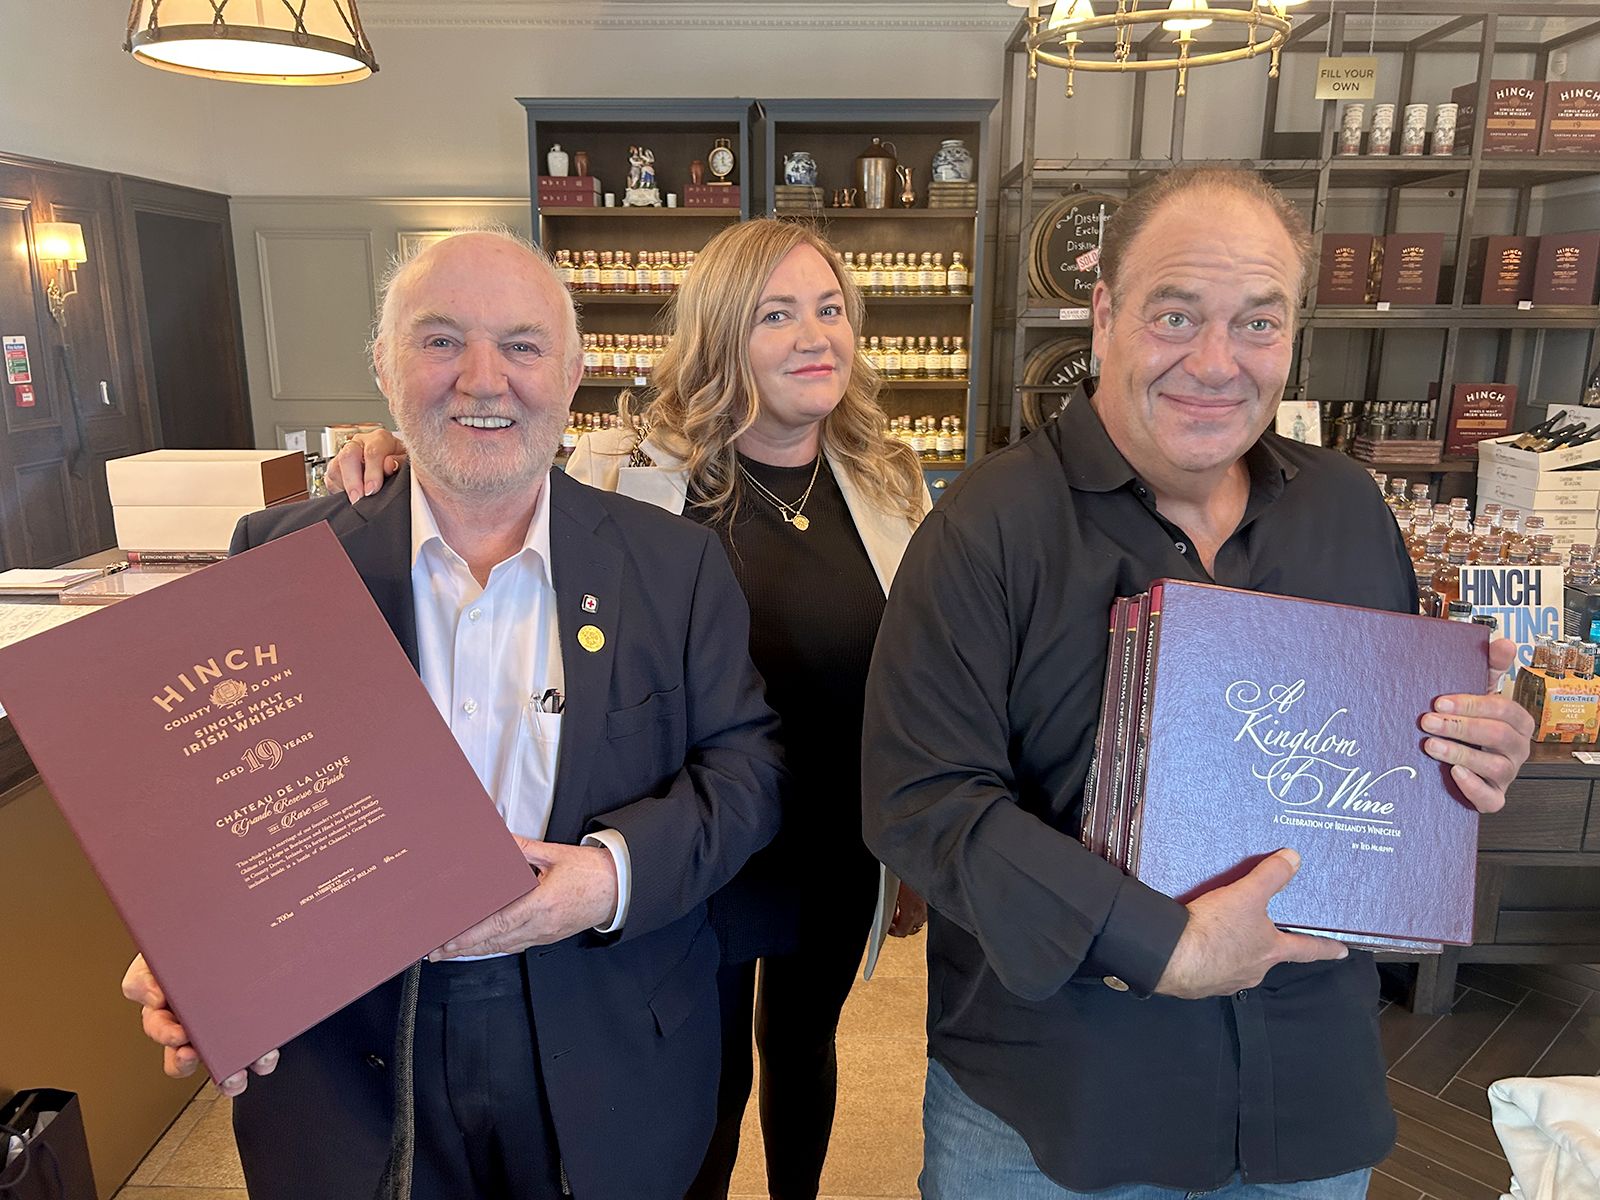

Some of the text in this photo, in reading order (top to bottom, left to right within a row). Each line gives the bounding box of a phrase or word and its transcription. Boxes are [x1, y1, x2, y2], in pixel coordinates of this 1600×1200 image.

[1321, 70, 1374, 78] FILL YOUR
[1333, 83, 1359, 91] OWN
[1496, 87, 1534, 100] HINCH
[1560, 89, 1600, 101] HINCH
[1080, 252, 1098, 268] SOLD
[1074, 279, 1091, 290] Pric
[1052, 357, 1087, 386] HIN
[1466, 391, 1506, 402] HINCH
[1461, 569, 1541, 606] HINCH
[1144, 631, 1154, 684] KINGDOM
[152, 644, 279, 713] HINCH
[1121, 646, 1130, 699] KINGDOM
[164, 669, 293, 731] COUNTY DOWN
[1119, 702, 1125, 716] OF
[1142, 688, 1148, 702] OF
[1226, 679, 1305, 714] A
[183, 693, 305, 757] IRISH WHISKEY
[195, 691, 283, 739] SINGLE MALT
[1139, 704, 1148, 733] WINE
[1234, 707, 1361, 764] Kingdom
[215, 731, 314, 784] AGED 19 YEARS
[216, 755, 351, 828] CHÂTEAU DE LA LIGNE
[231, 763, 348, 837] Grande Reserve Finish
[1327, 766, 1417, 815] Wine
[277, 803, 313, 830] Rare
[1273, 815, 1279, 823] A
[1280, 815, 1323, 829] CELEBRATION
[1324, 822, 1334, 830] OF
[1335, 821, 1367, 834] IRELAND'S
[275, 834, 297, 848] marriage
[311, 828, 321, 836] and
[1360, 842, 1371, 850] TED
[1126, 837, 1134, 870] Murphy
[249, 866, 269, 879] County
[356, 864, 377, 878] IRELAND
